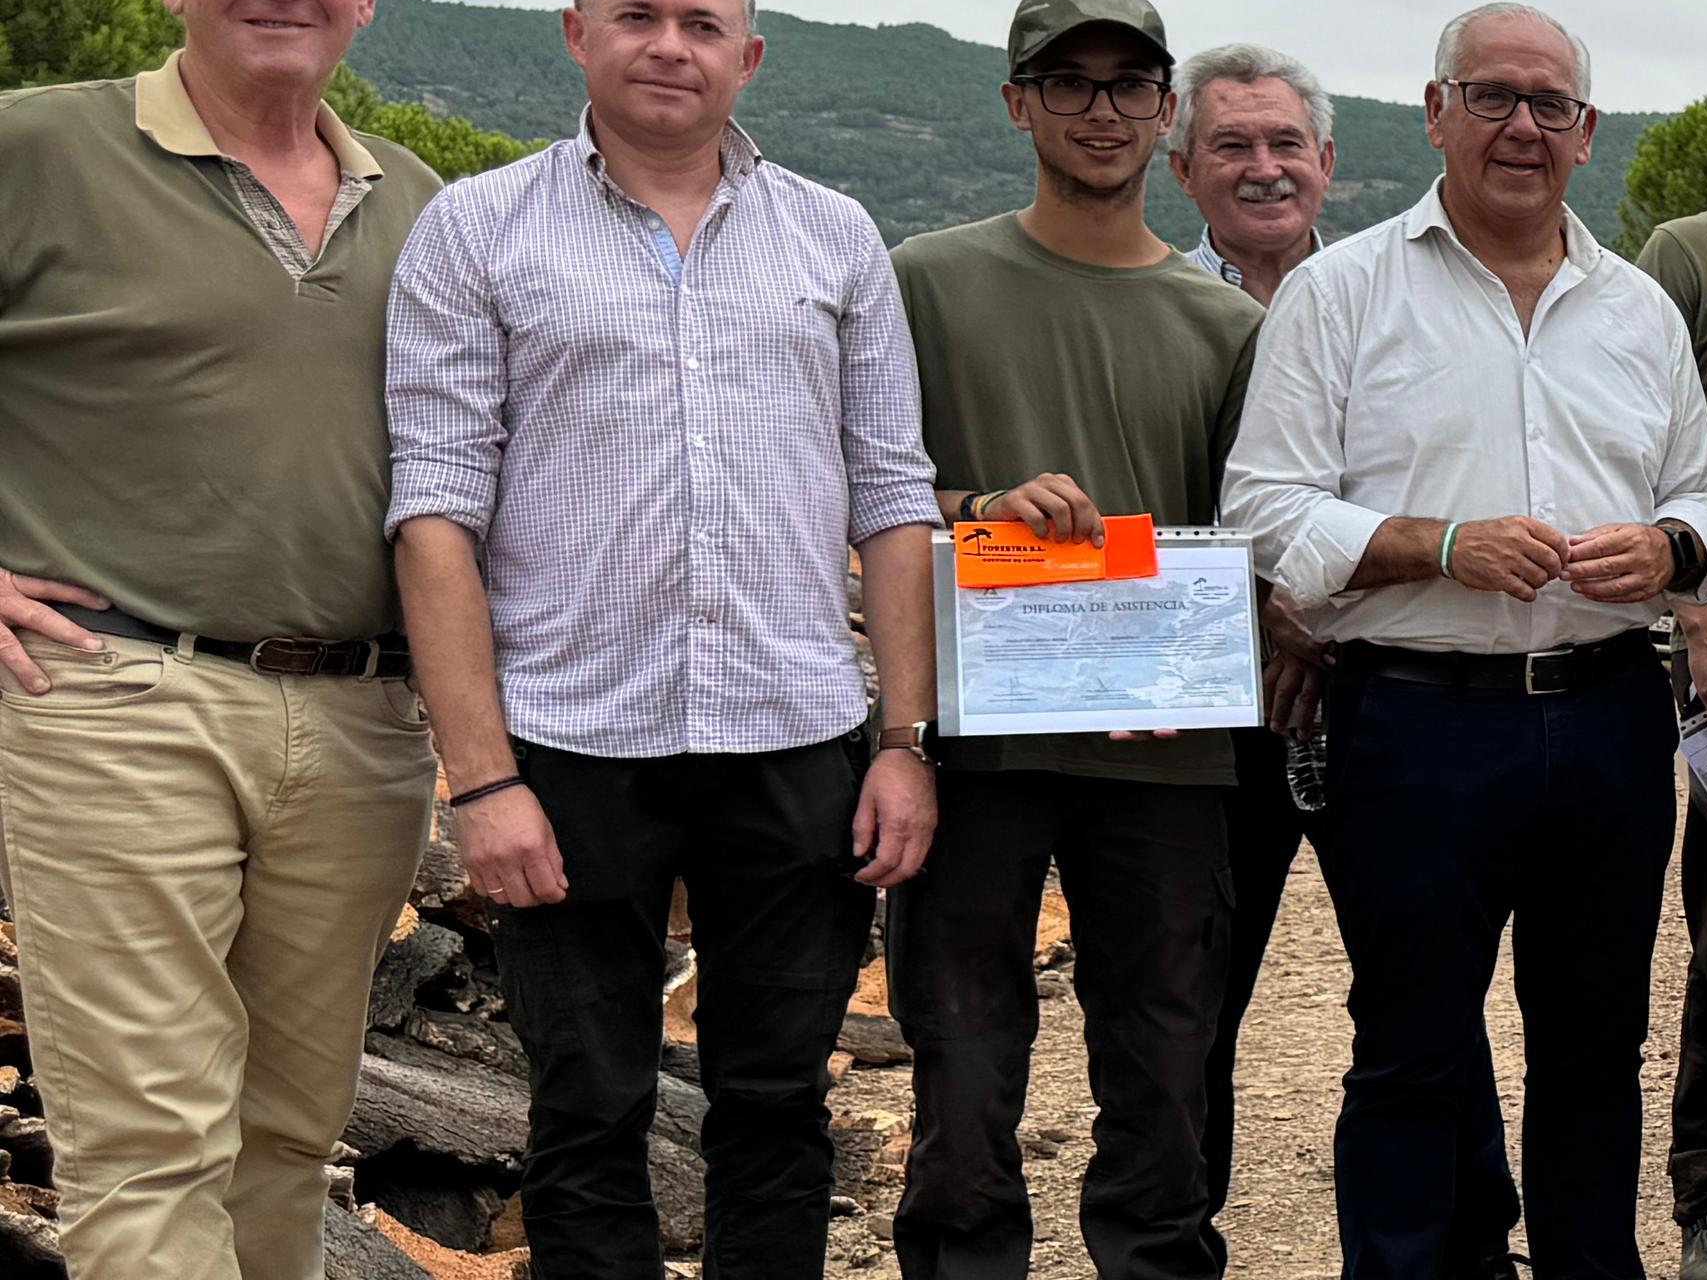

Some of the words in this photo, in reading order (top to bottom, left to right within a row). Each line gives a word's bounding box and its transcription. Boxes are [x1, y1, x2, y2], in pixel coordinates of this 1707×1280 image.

[1023, 603, 1085, 614] DIPLOMA
[1090, 602, 1107, 612] DE
[1112, 600, 1187, 612] ASISTENCIA
